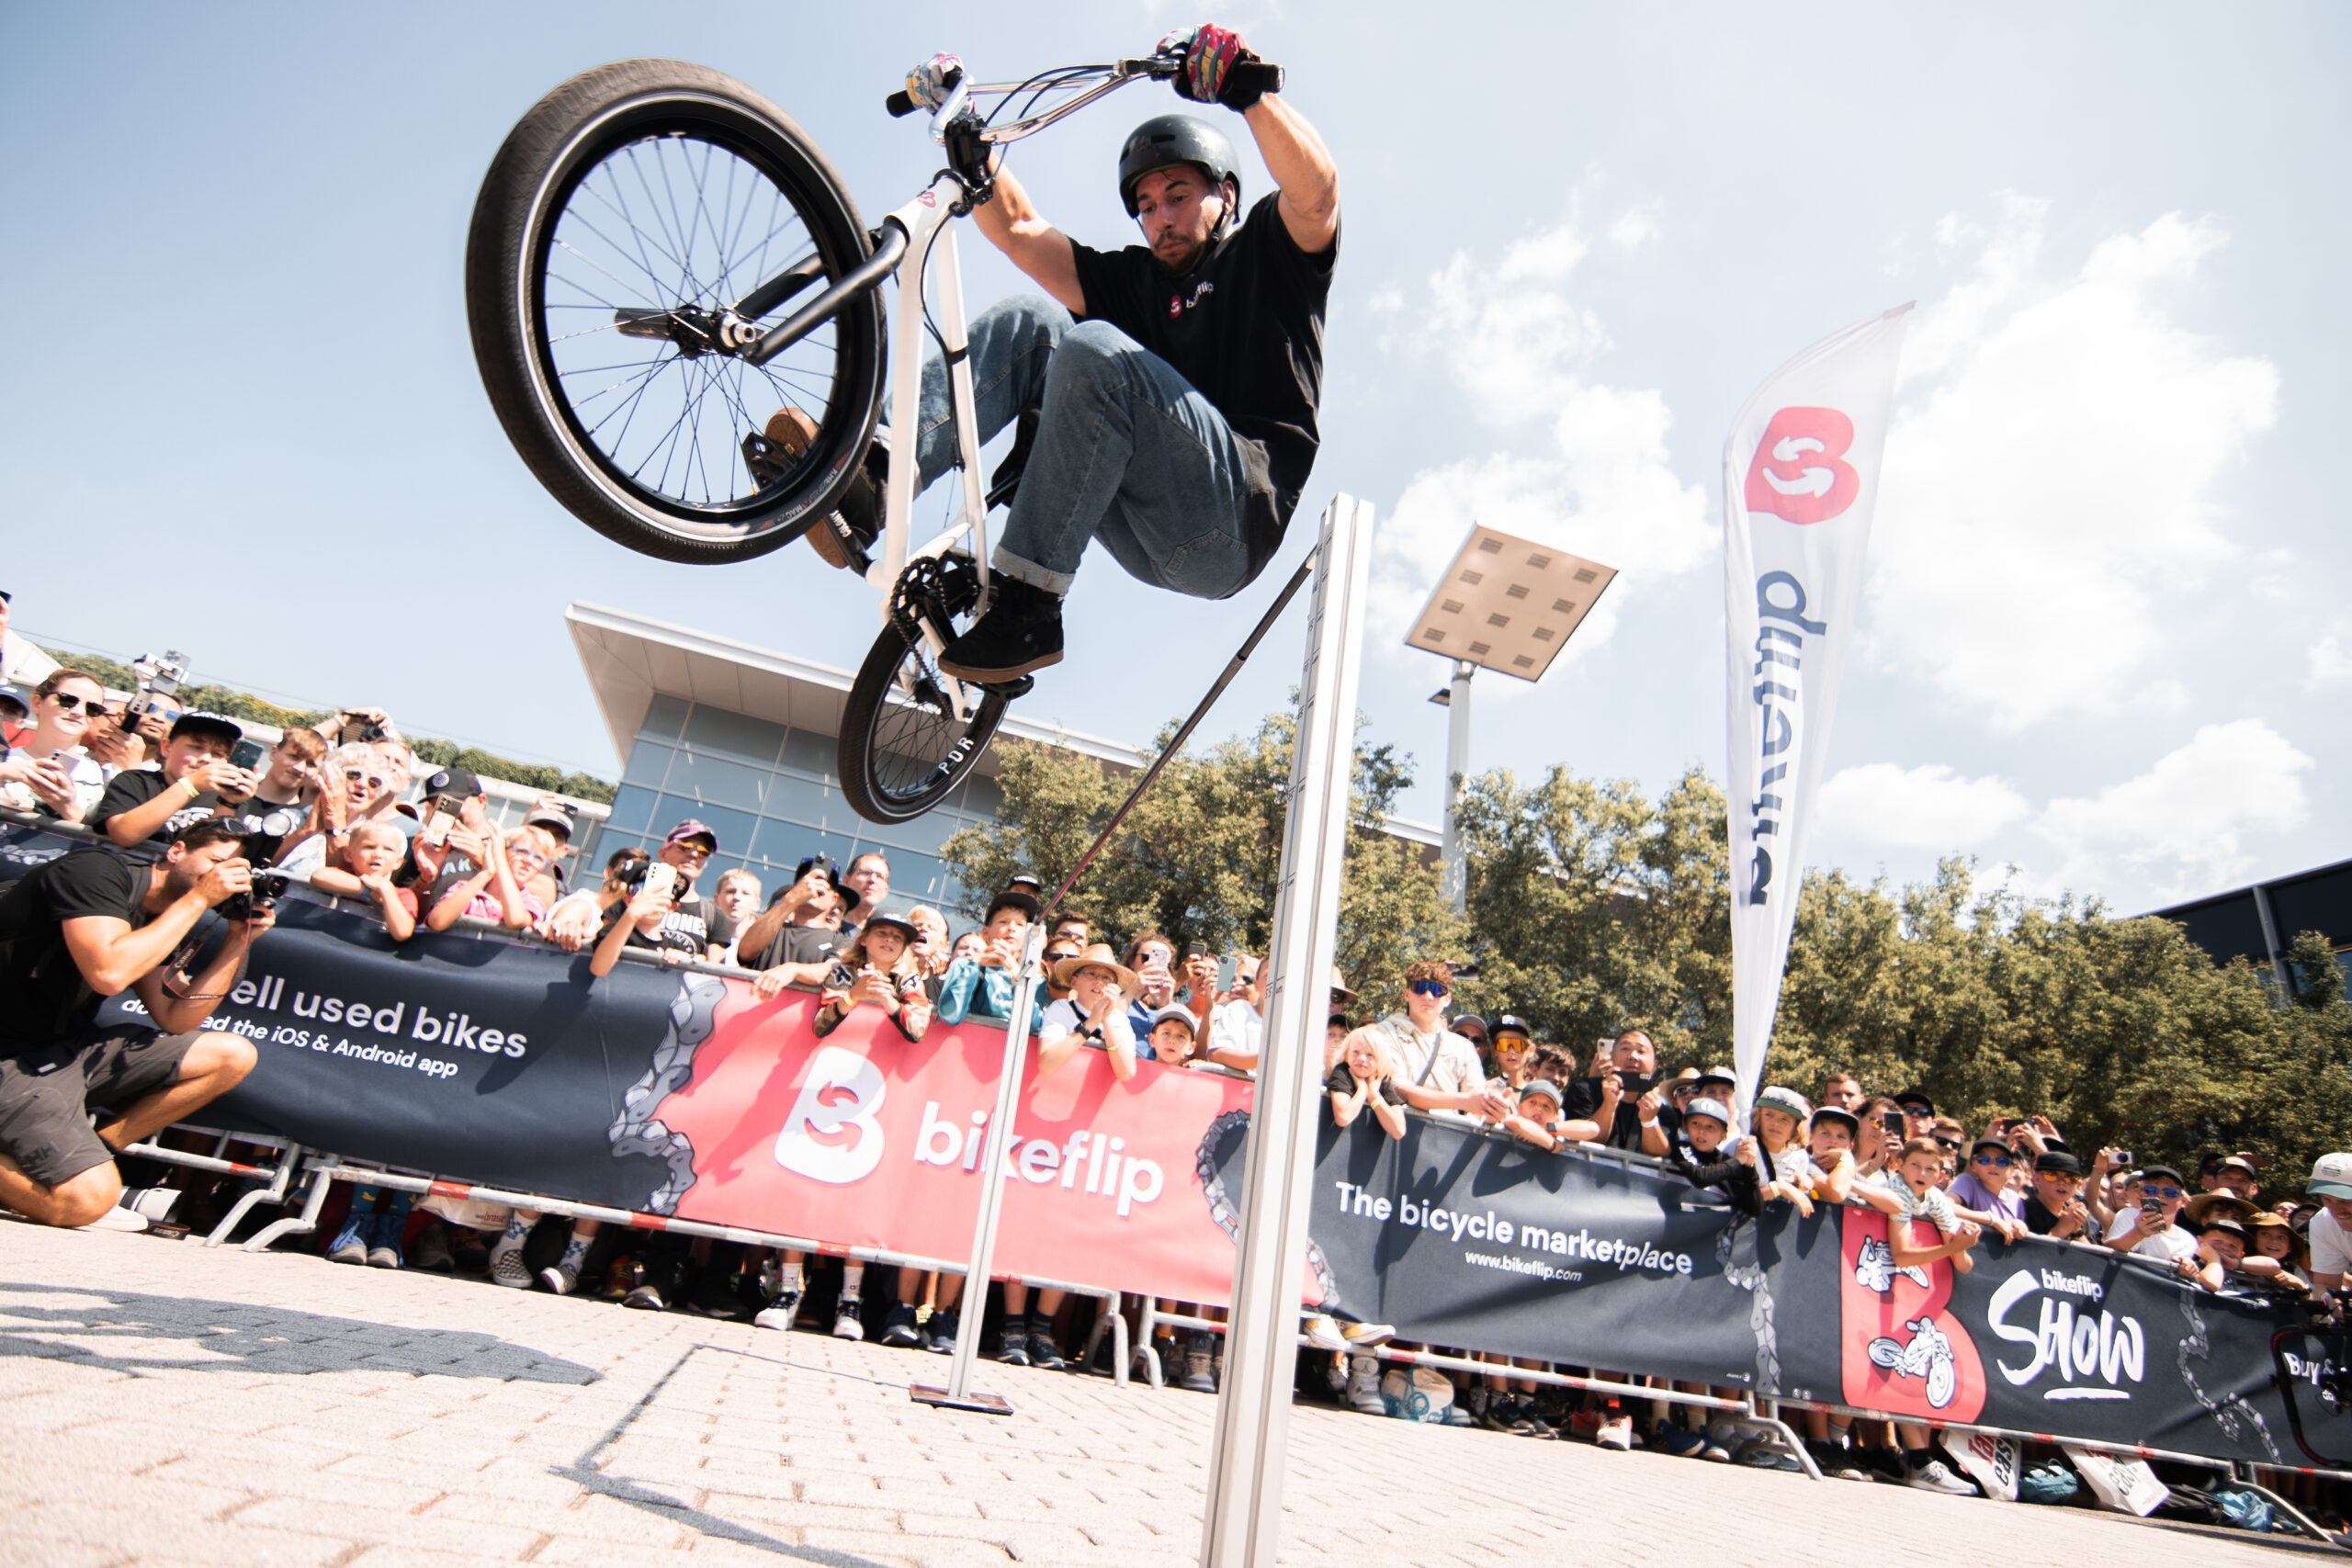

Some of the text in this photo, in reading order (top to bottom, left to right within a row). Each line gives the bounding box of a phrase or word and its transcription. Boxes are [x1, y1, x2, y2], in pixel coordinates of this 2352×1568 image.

[231, 976, 528, 1058] ell used bikes
[232, 1020, 268, 1041] the
[270, 1025, 311, 1048] iOS
[311, 1034, 330, 1053] &
[332, 1038, 418, 1069] Android
[417, 1058, 458, 1079] app
[1335, 1180, 1693, 1276] The bicycle marketplace
[1464, 1252, 1583, 1282] www.bikeflip.com
[2041, 1268, 2104, 1303] bikeflip
[1987, 1269, 2145, 1386] SHOW
[2283, 1352, 2321, 1385] Buy
